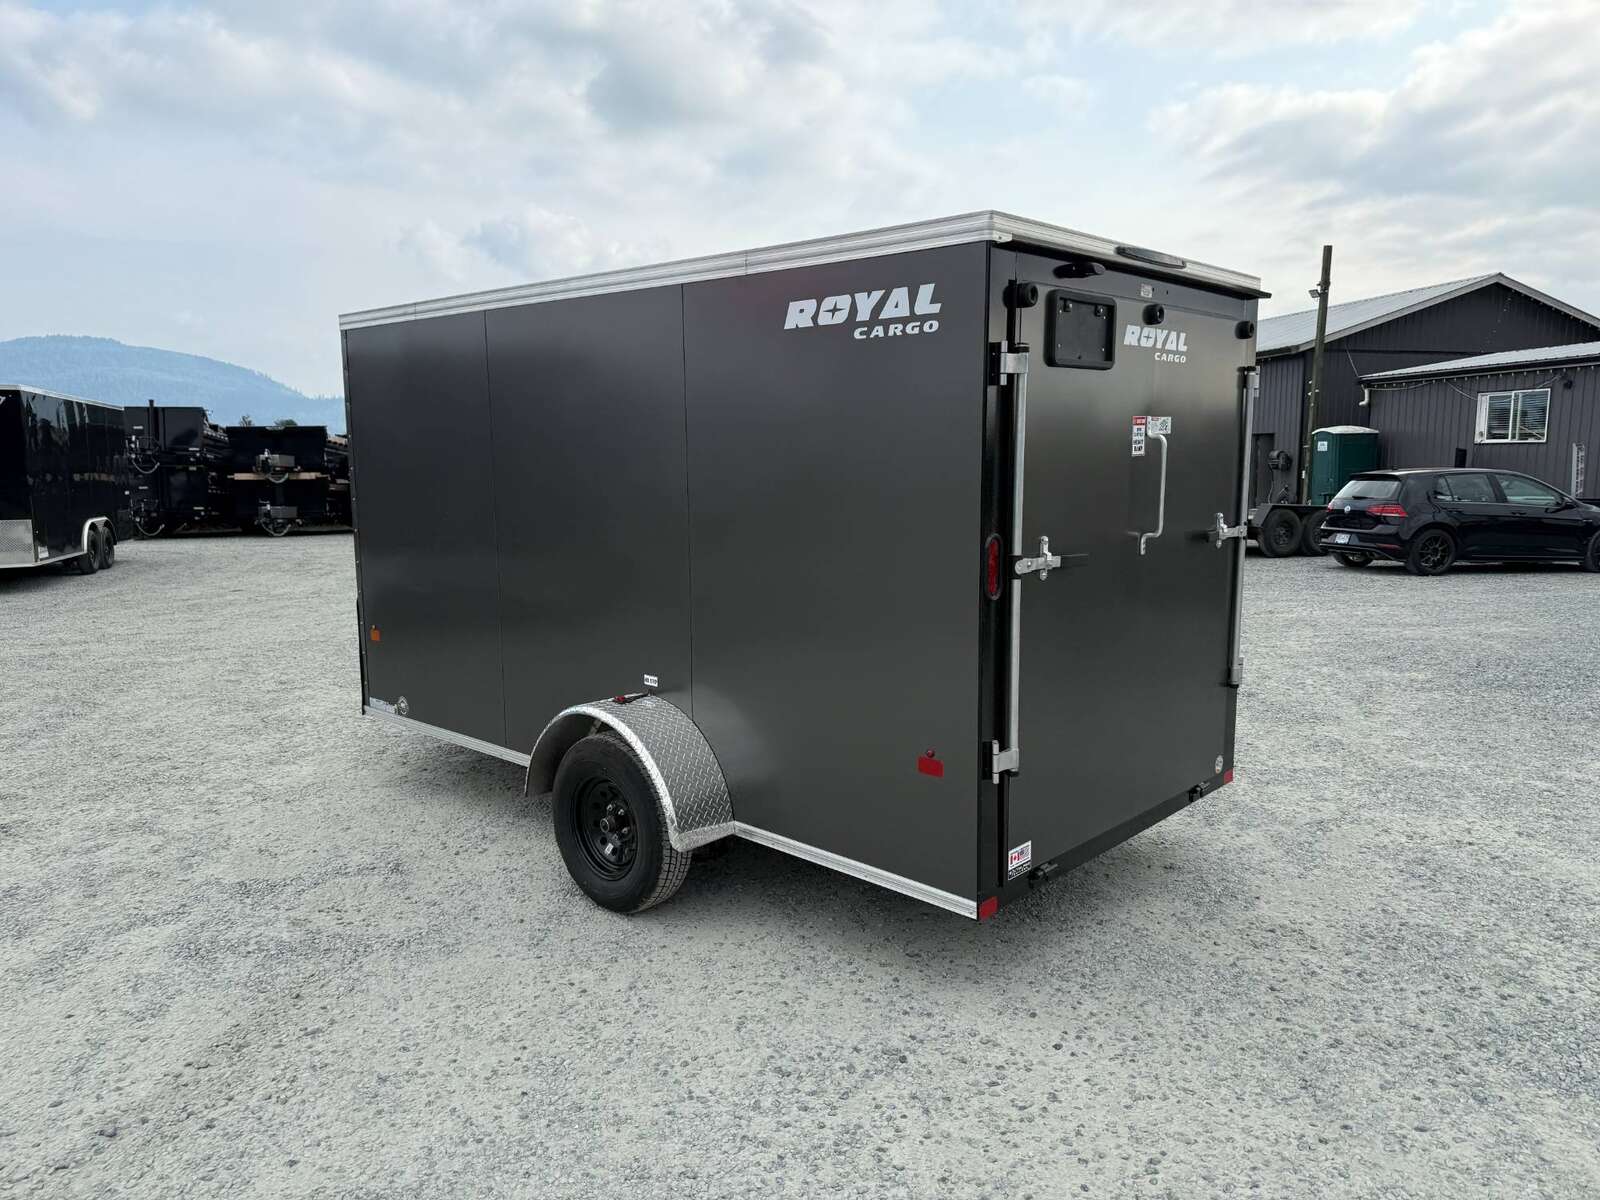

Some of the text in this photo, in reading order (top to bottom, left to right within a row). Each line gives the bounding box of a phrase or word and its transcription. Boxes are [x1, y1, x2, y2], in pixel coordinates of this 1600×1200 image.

[784, 284, 942, 329] ROYAL
[853, 320, 940, 340] CARGO
[1123, 324, 1188, 352] ROYAL
[1154, 352, 1187, 364] CARGO
